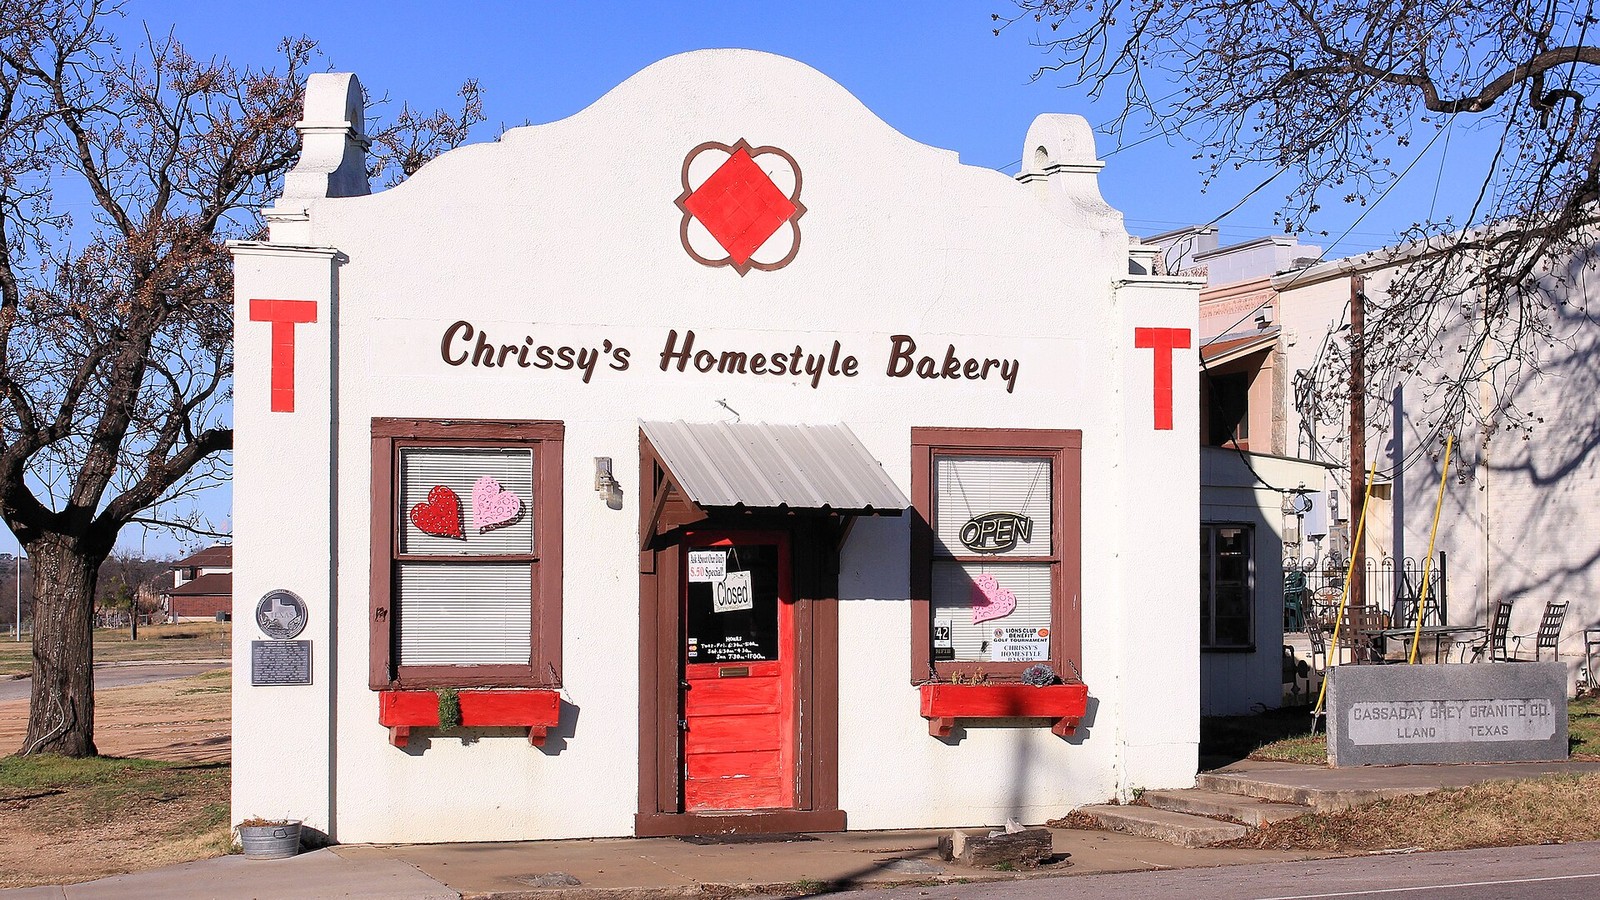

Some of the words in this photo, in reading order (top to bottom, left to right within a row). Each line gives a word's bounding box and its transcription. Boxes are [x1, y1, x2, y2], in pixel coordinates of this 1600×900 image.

[441, 321, 630, 384] Chrissy's
[660, 330, 858, 389] Homestyle
[887, 335, 1019, 393] Bakery
[960, 516, 1031, 545] OPEN
[717, 579, 748, 606] Closed
[935, 627, 948, 640] 42
[1353, 706, 1425, 720] CASSADAY
[1430, 705, 1464, 719] GREY
[1470, 703, 1526, 718] GRANITE
[1530, 703, 1550, 717] CO.
[1397, 727, 1436, 738] LLANO
[1468, 725, 1509, 737] TEXAS
